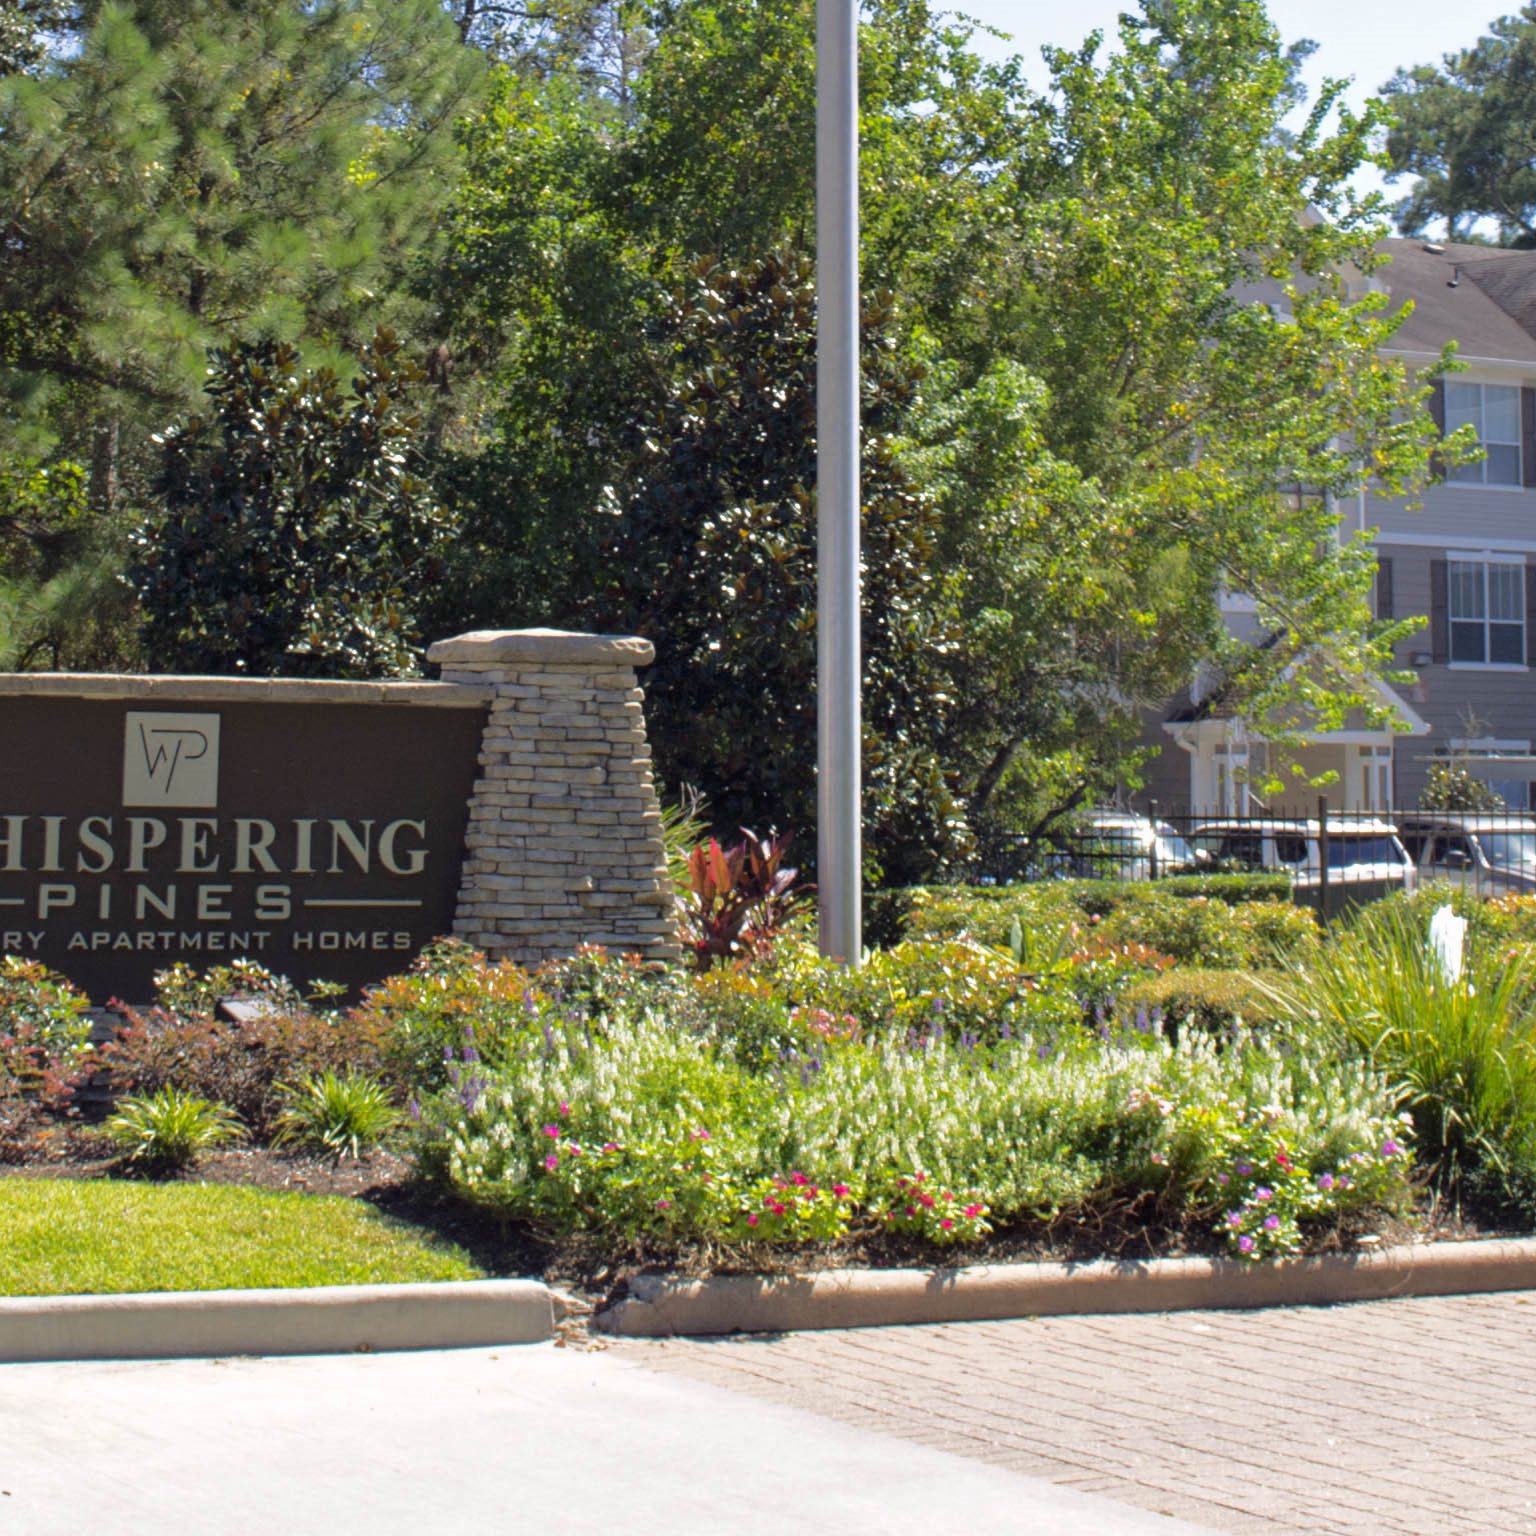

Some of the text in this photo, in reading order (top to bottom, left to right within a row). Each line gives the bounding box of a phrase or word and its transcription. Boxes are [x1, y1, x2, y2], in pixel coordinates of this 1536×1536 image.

[38, 883, 292, 920] PINES
[67, 931, 271, 950] APARTMENT
[292, 931, 411, 950] HOMES
